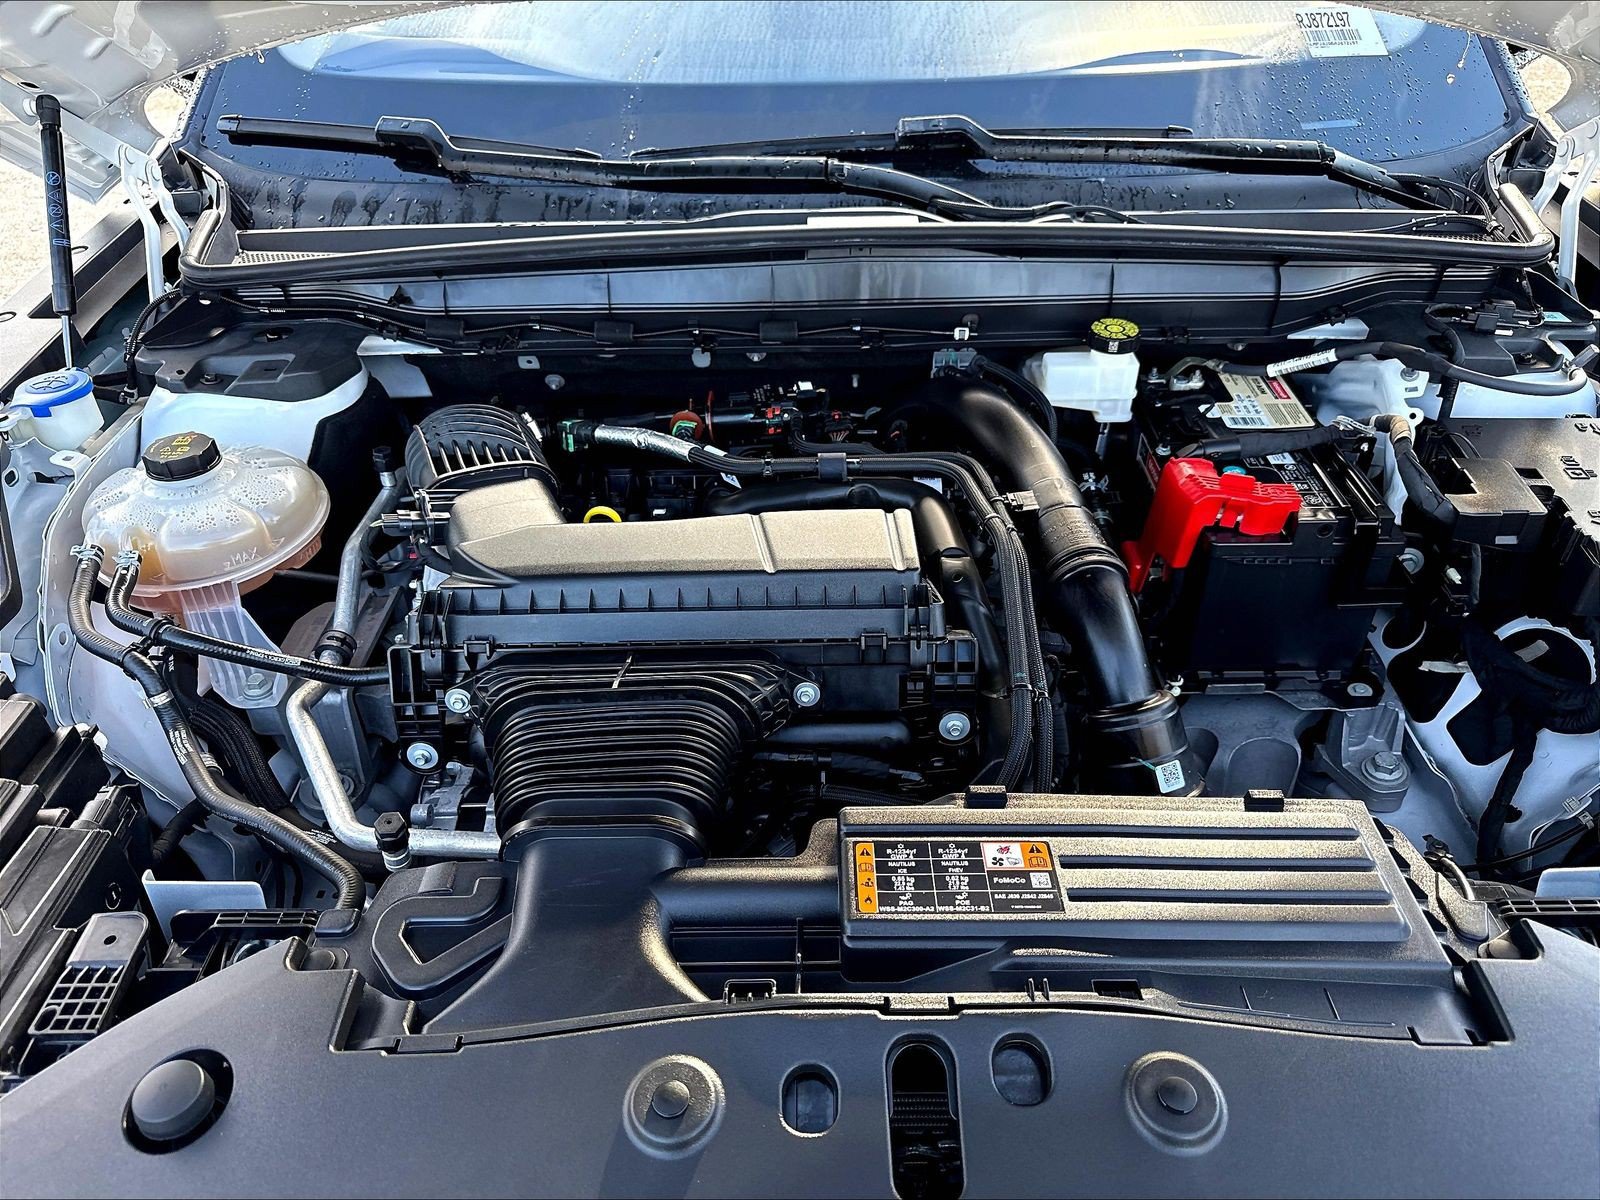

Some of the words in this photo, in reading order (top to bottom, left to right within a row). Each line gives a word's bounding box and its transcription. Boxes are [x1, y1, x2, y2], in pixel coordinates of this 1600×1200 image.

[1295, 11, 1351, 29] RJ872197
[230, 546, 262, 566] MAX
[886, 849, 917, 857] R-1234yf
[937, 848, 969, 856] R-1234yf
